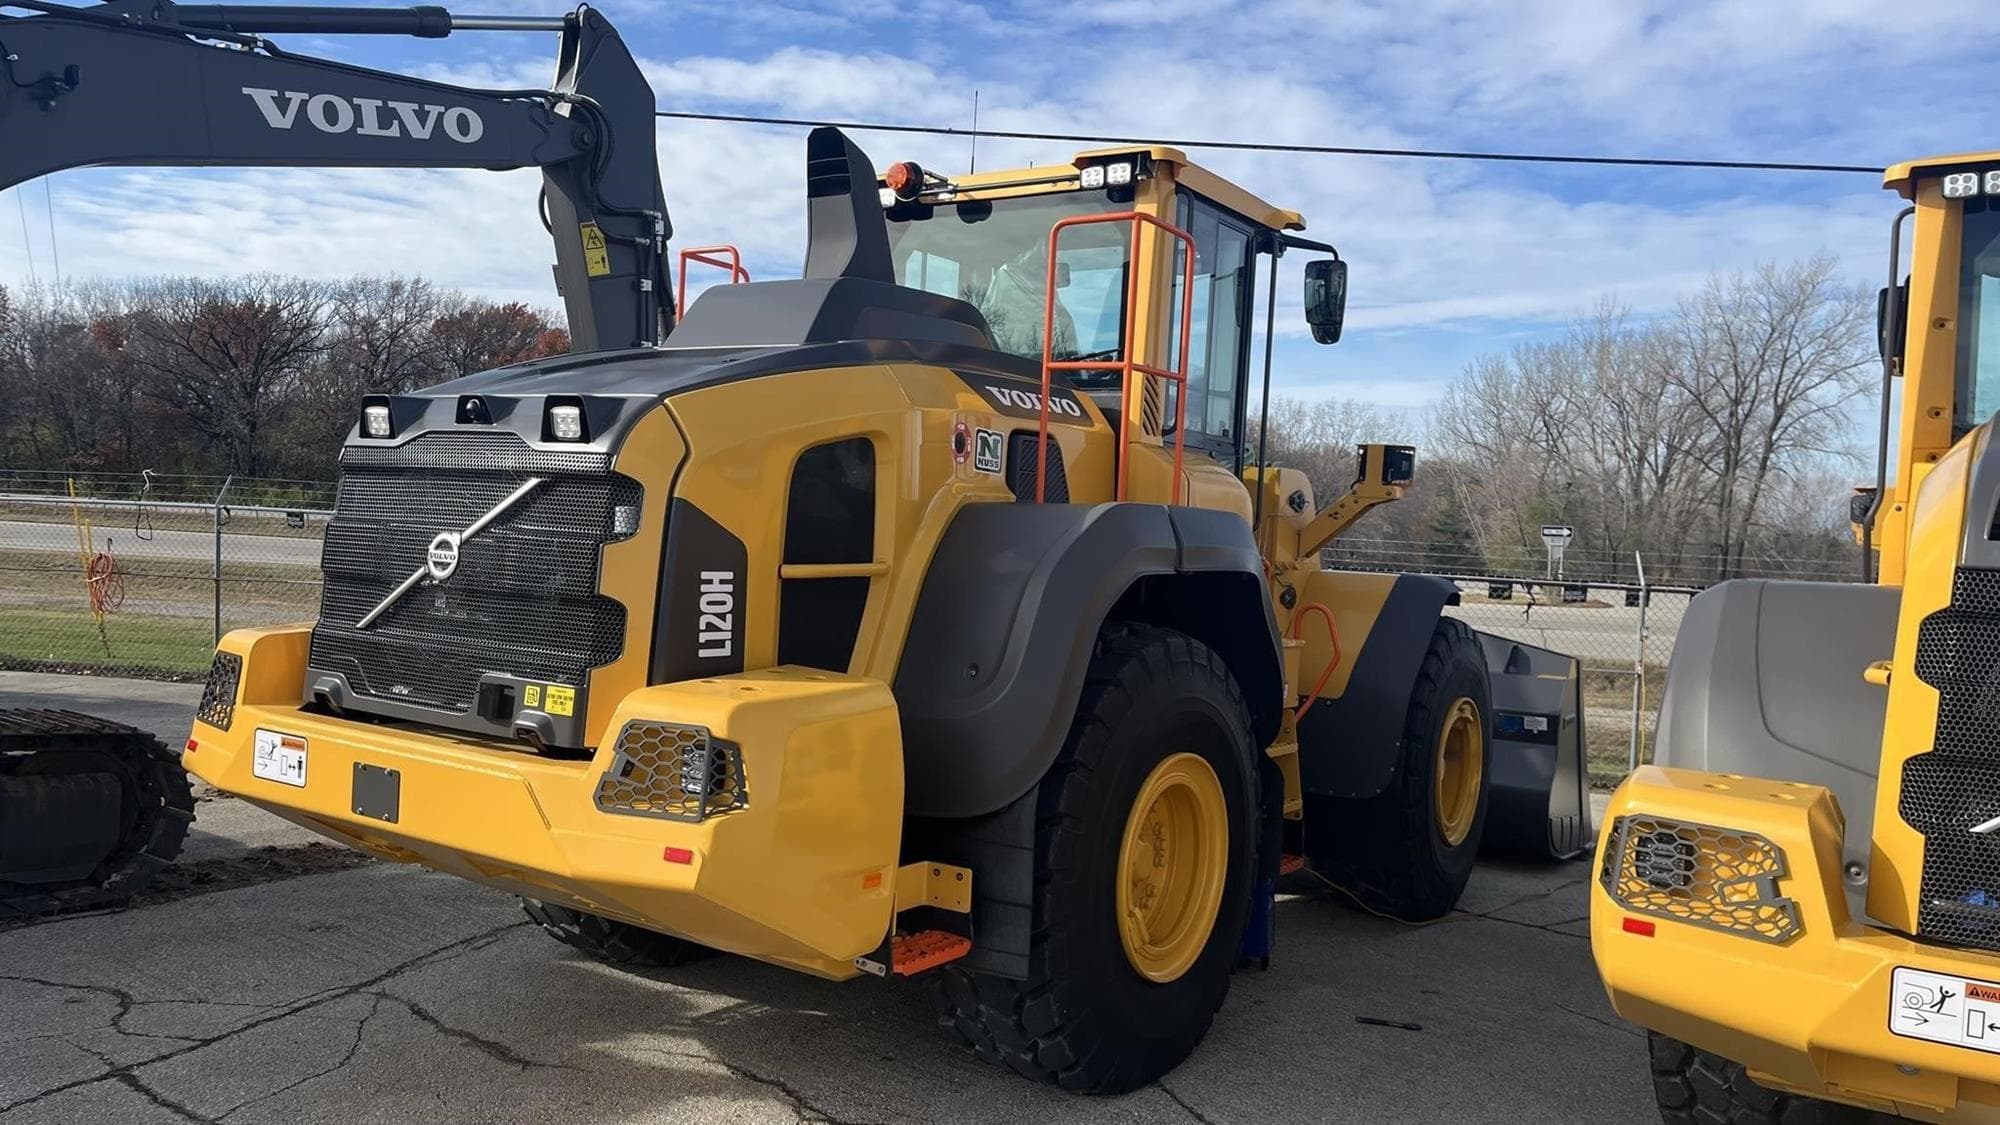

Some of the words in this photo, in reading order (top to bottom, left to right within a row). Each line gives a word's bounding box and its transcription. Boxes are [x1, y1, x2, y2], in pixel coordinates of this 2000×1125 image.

[241, 87, 484, 143] VOLVO
[977, 457, 1000, 469] NUSS
[429, 551, 457, 561] VOLVO
[698, 571, 734, 658] L120H
